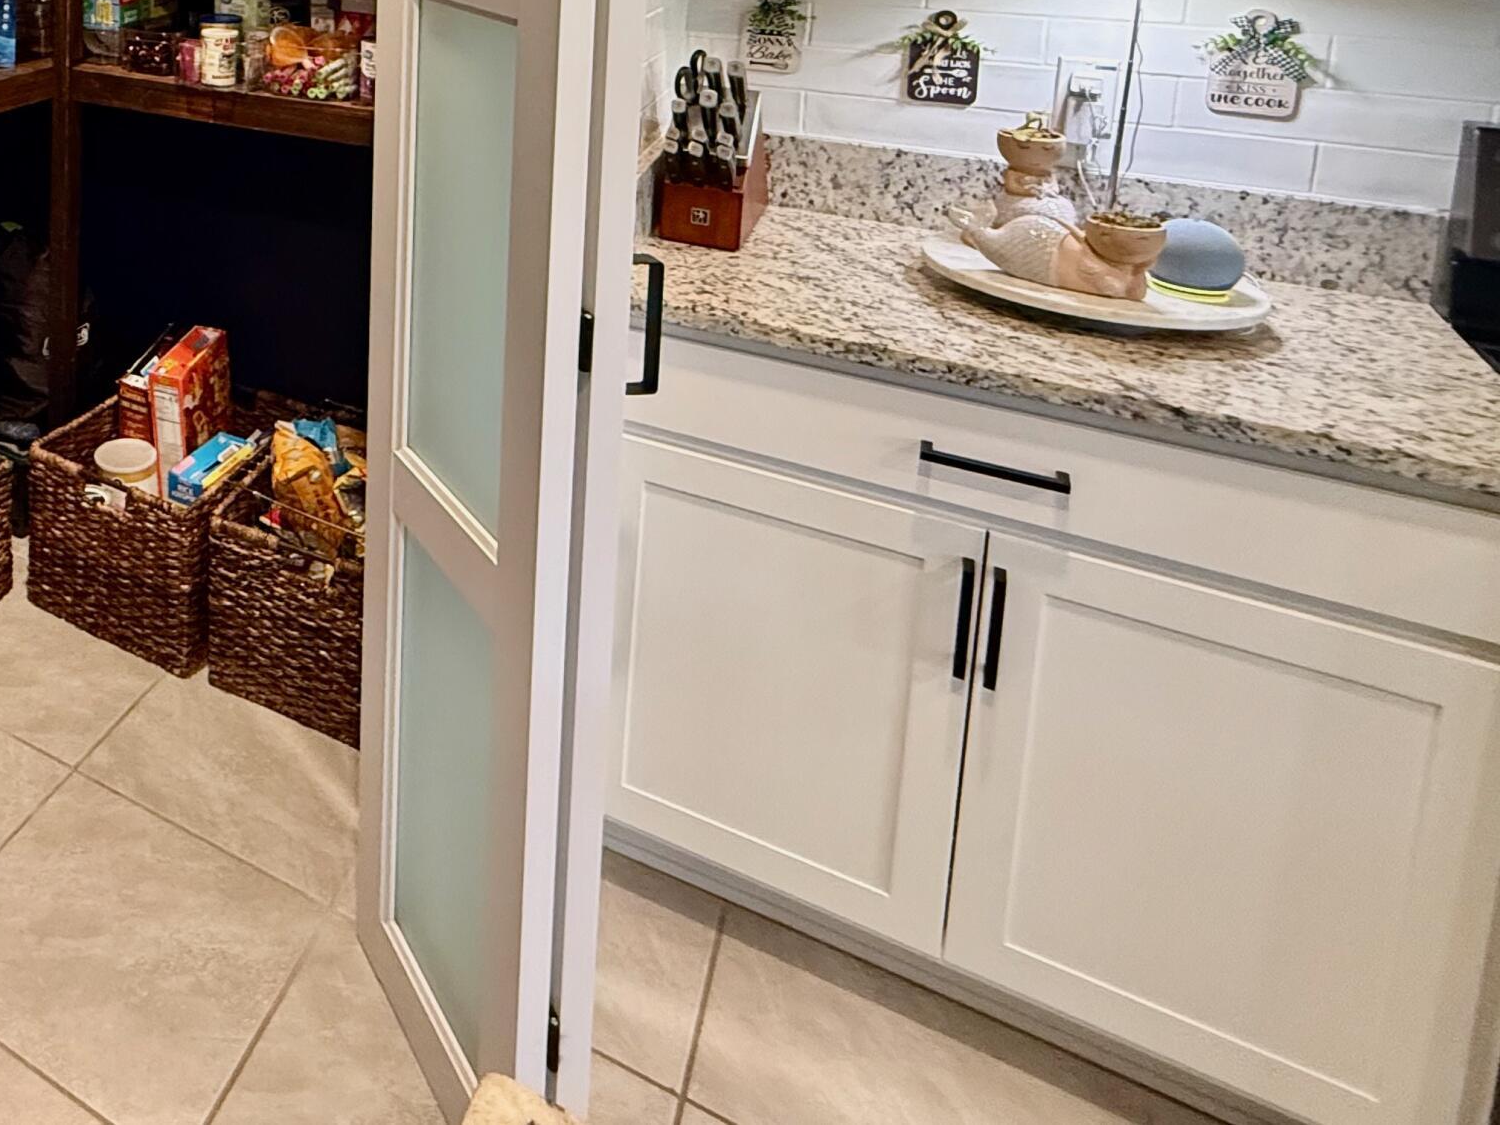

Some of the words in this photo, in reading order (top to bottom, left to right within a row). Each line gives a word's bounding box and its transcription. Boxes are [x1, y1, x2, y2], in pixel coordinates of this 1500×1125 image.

[746, 44, 793, 60] Bake
[950, 60, 972, 69] LICK
[912, 75, 972, 99] Spoon
